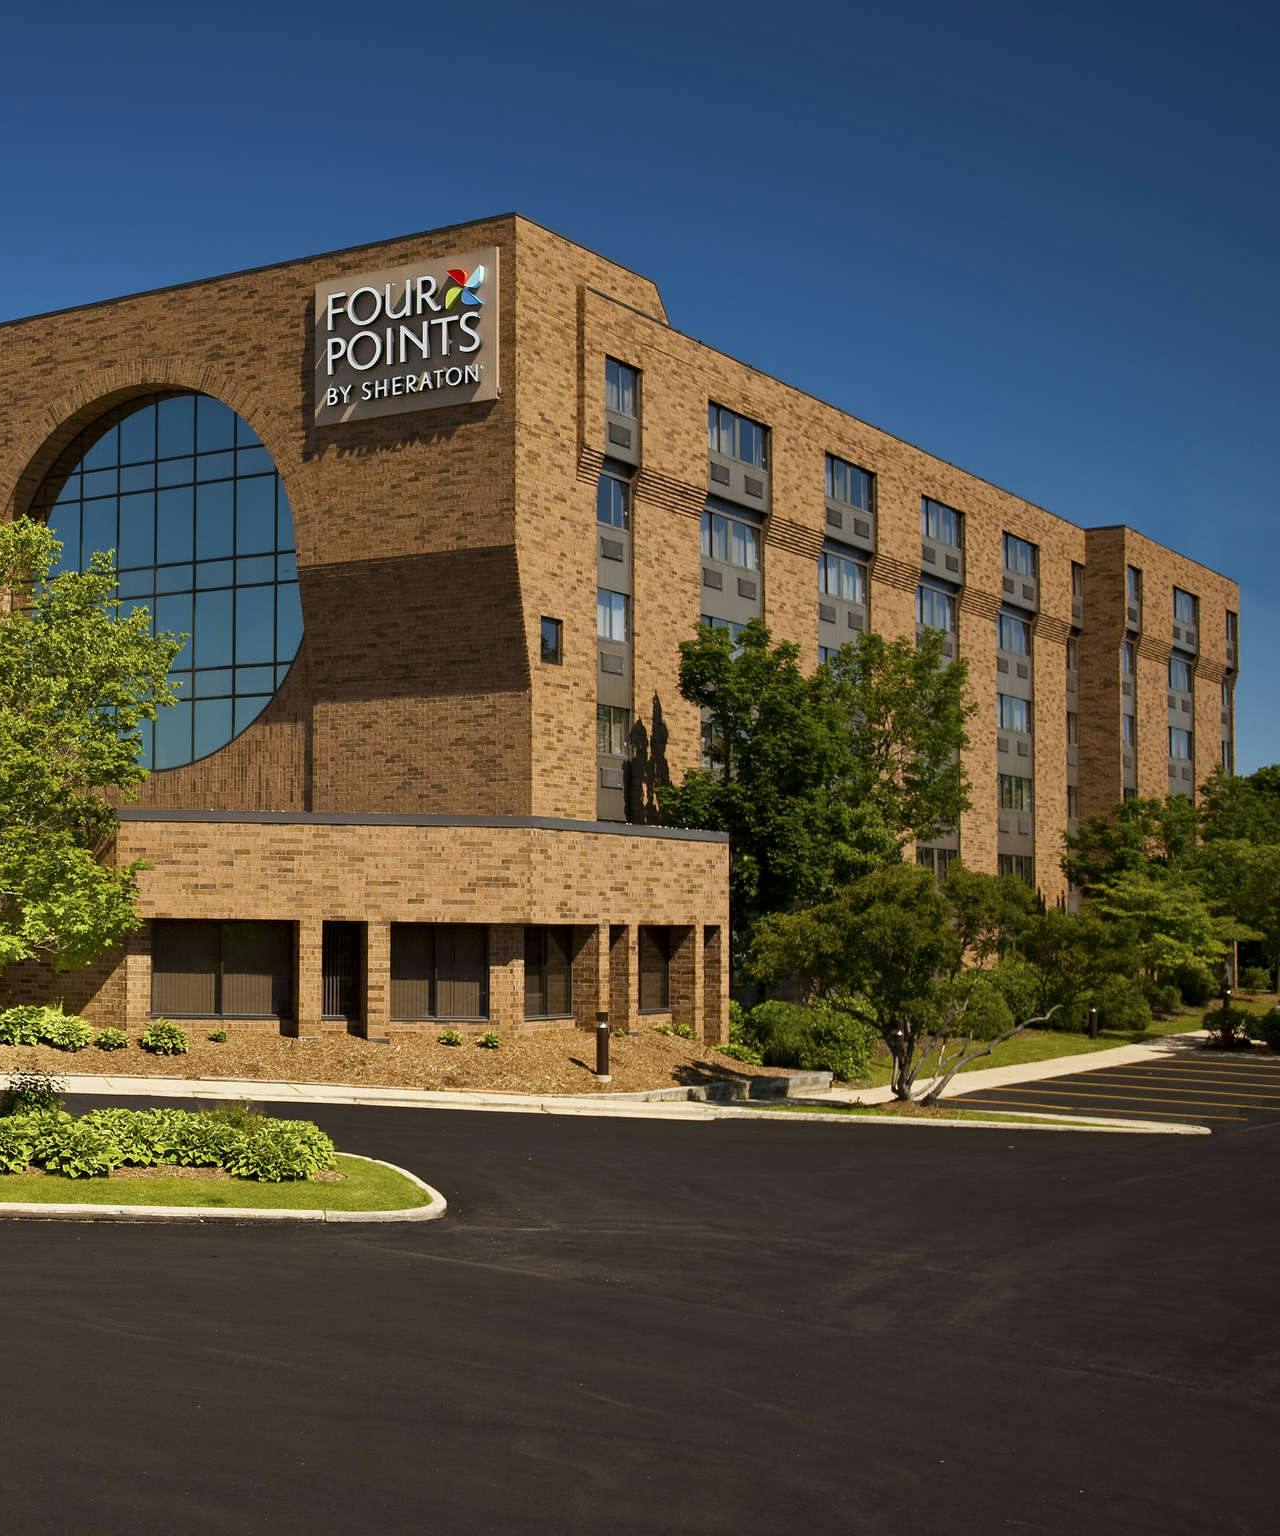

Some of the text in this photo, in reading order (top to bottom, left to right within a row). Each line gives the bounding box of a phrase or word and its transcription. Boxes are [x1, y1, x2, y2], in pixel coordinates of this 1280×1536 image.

[327, 275, 443, 332] FOUR
[327, 311, 482, 376] POINTS
[326, 363, 481, 406] BY SHERATON
